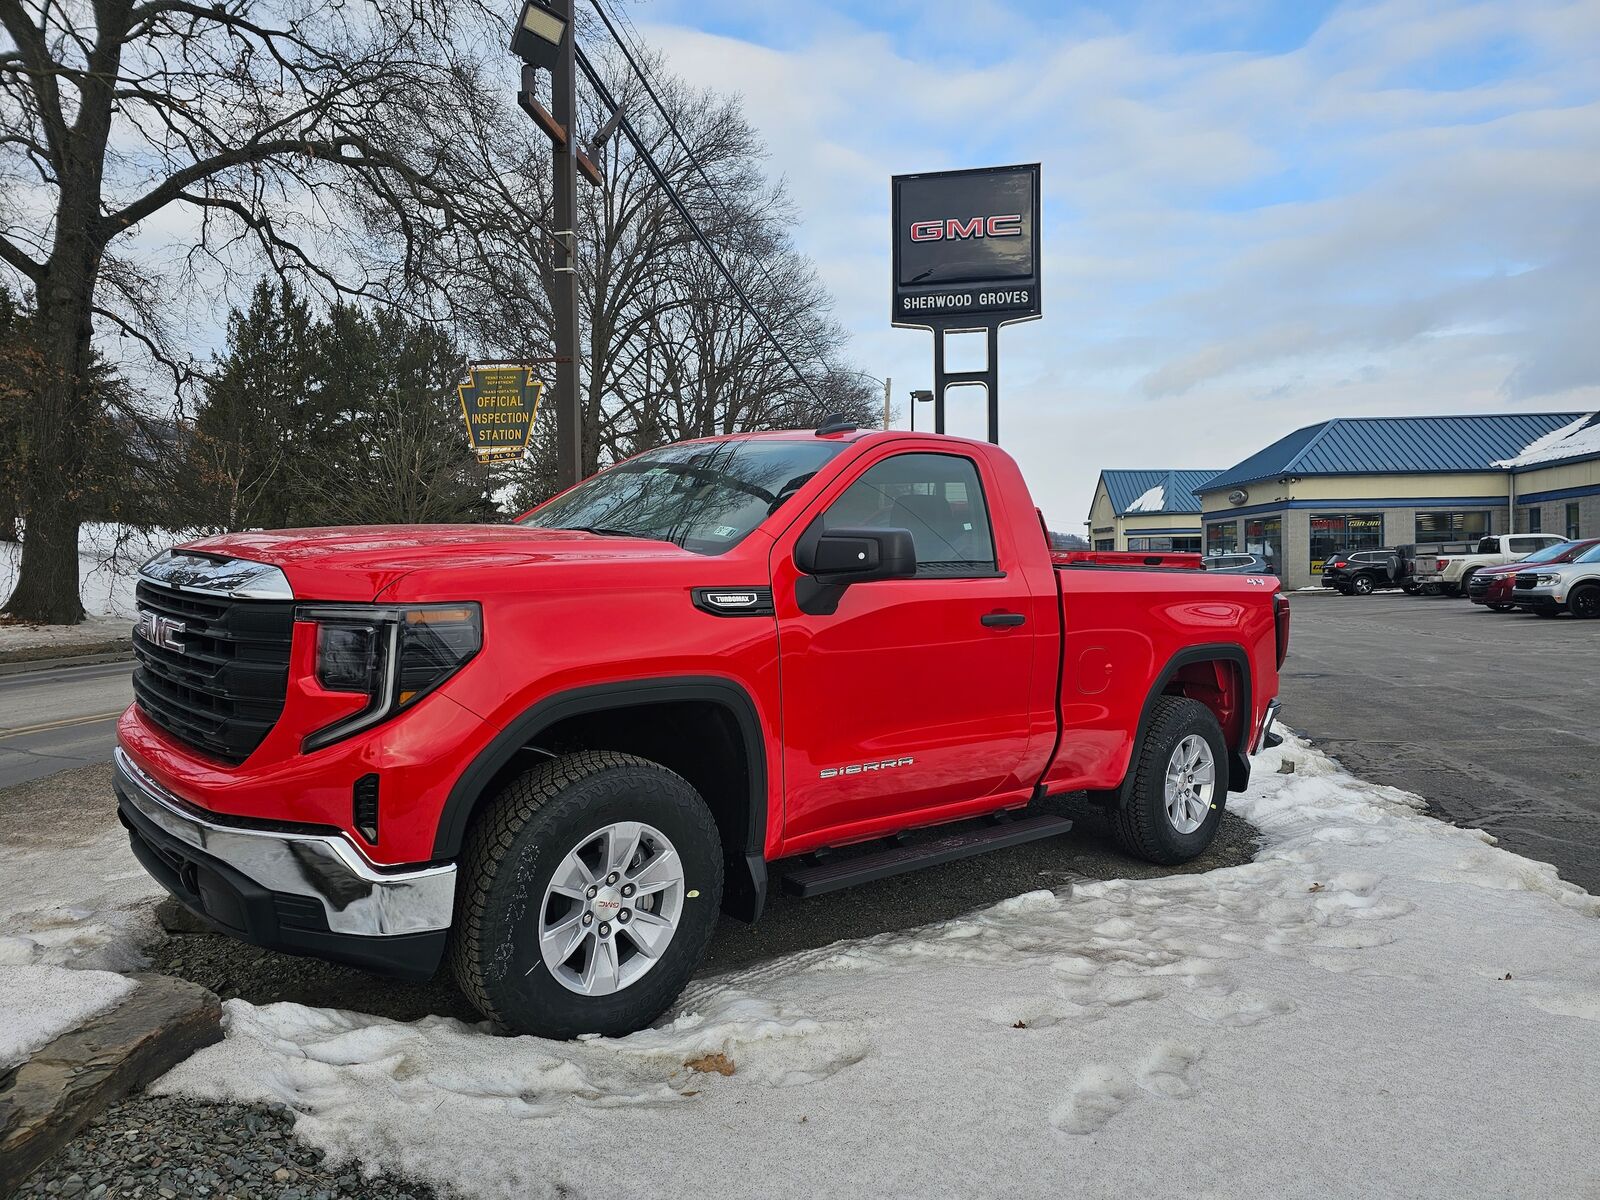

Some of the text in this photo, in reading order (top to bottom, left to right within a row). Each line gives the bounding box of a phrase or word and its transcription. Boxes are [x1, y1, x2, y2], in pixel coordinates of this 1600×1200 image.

[911, 214, 1021, 242] GMC
[903, 291, 1029, 310] SHERWOOD GROVES
[477, 396, 524, 408] OFFICIAL
[471, 412, 529, 424] INSPECTION
[479, 429, 522, 441] STATION
[138, 609, 186, 654] GMC
[820, 756, 914, 779] SIERRA
